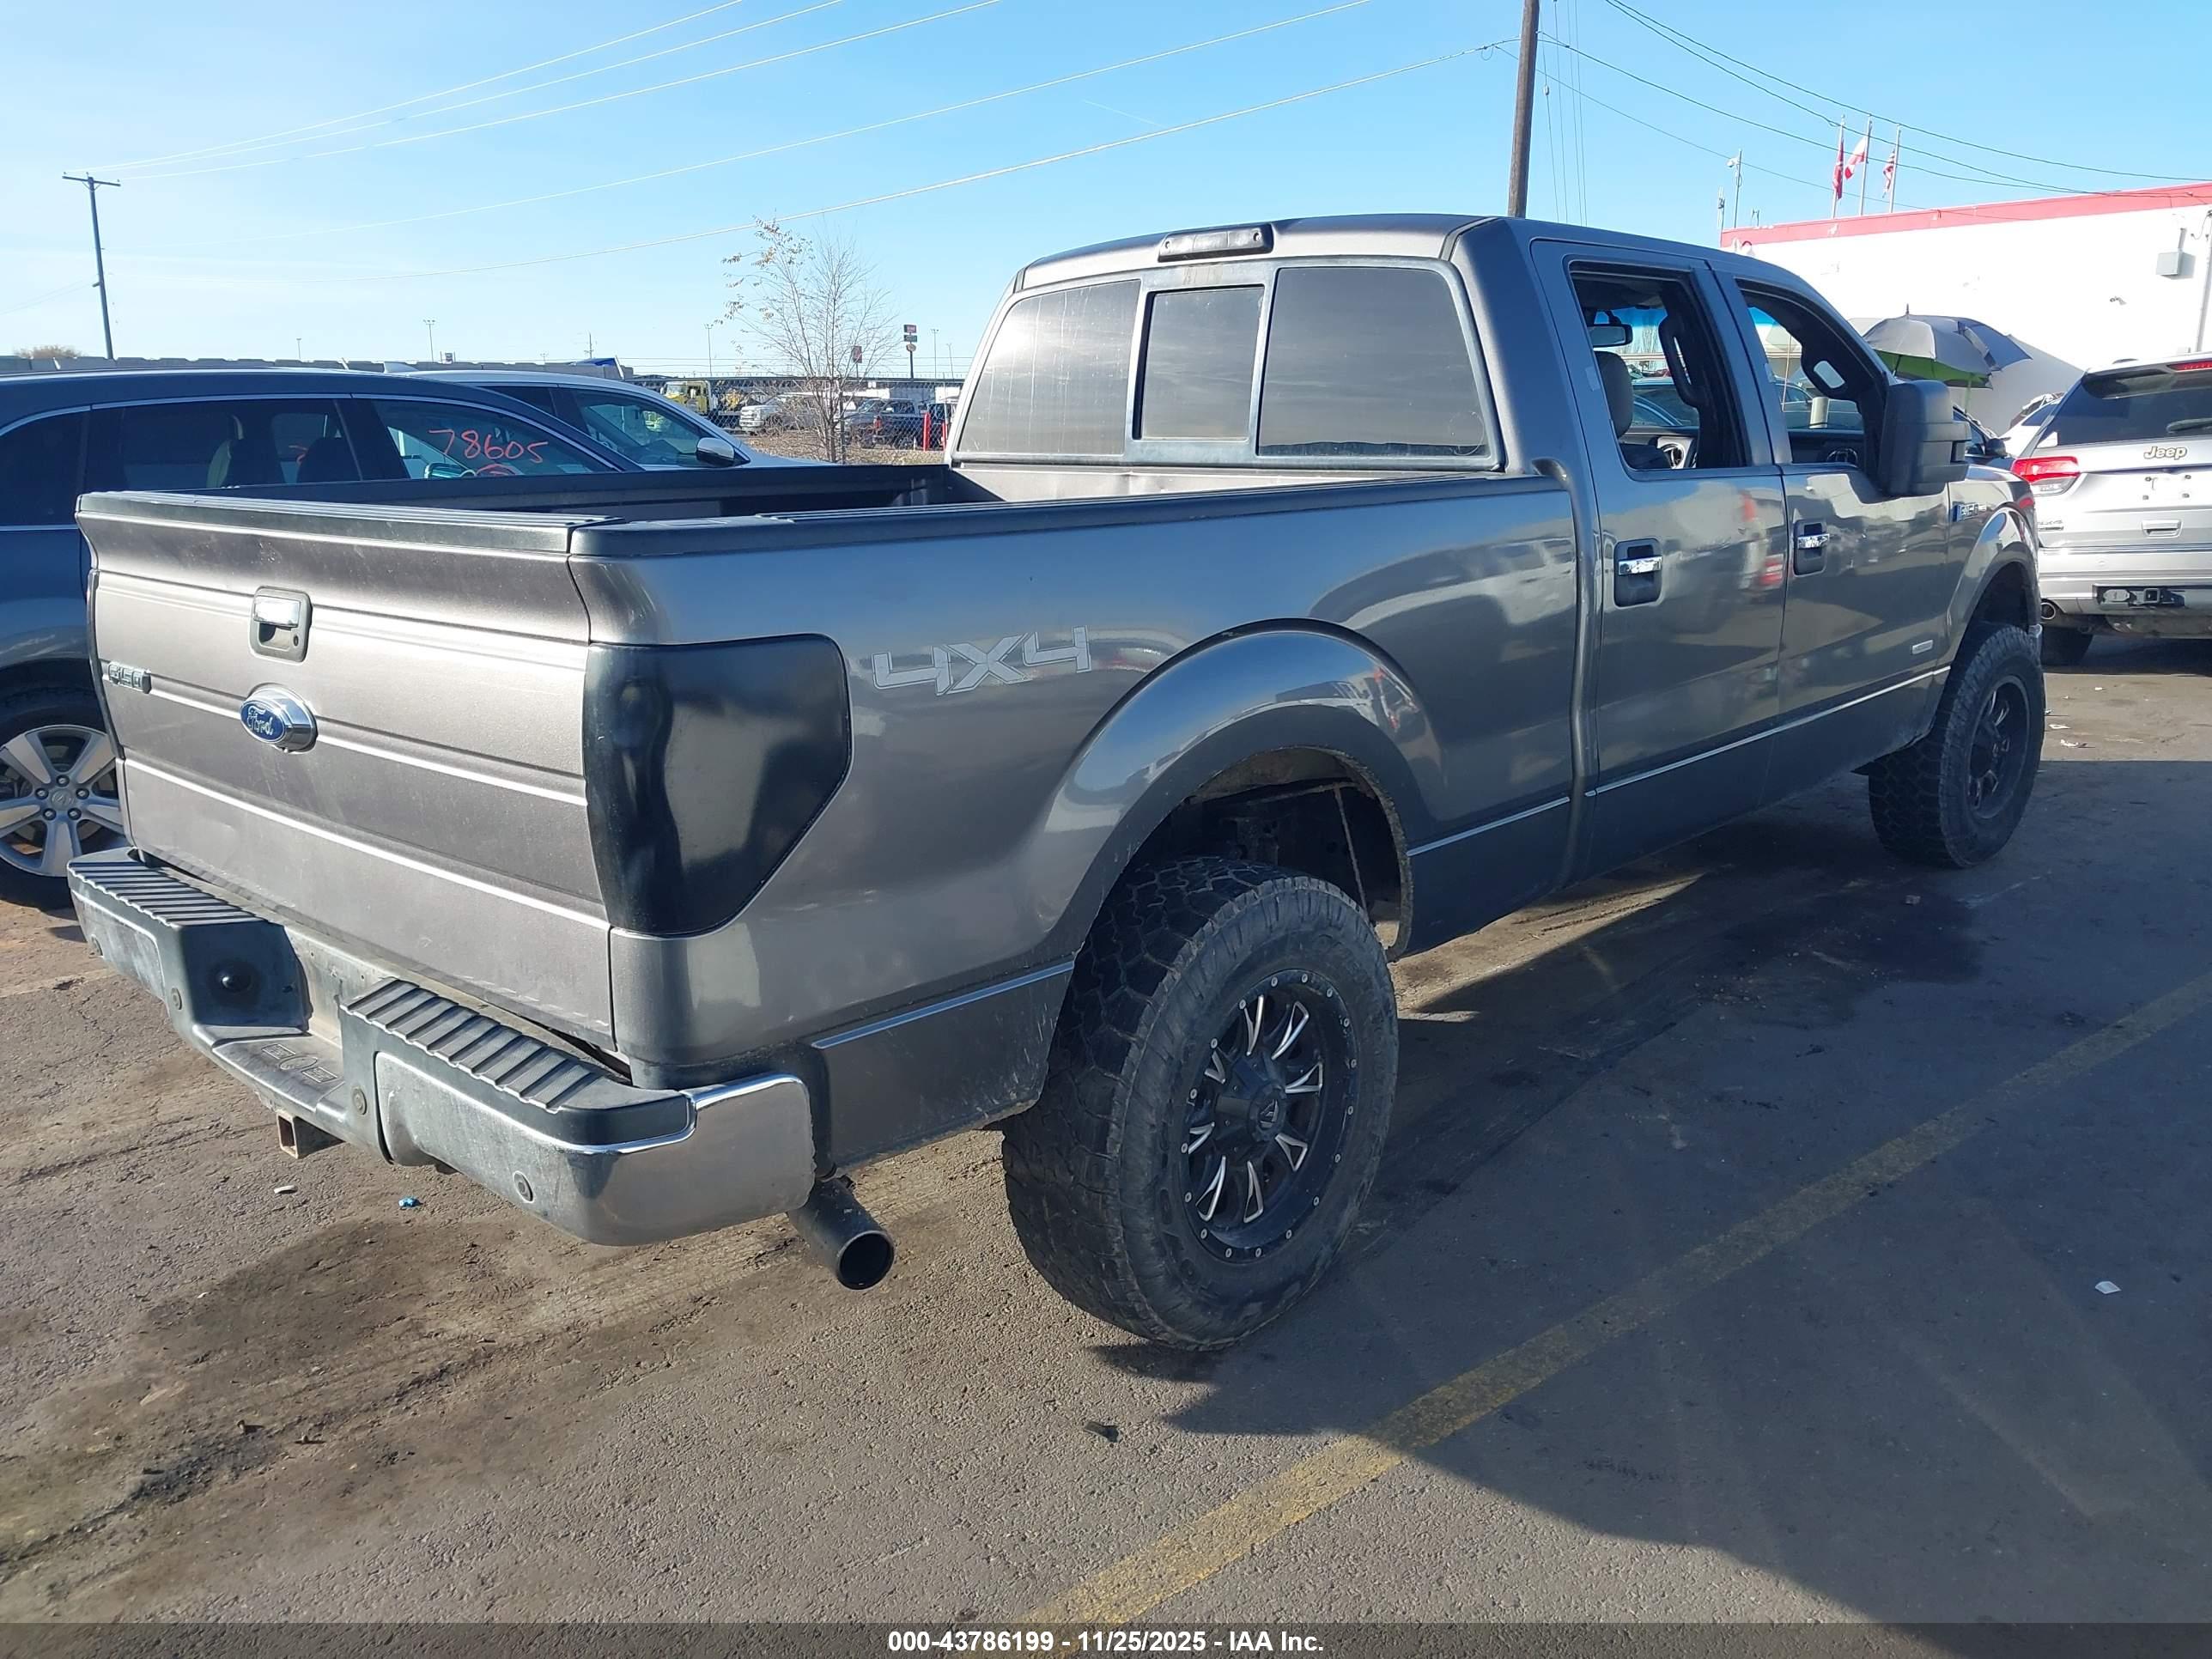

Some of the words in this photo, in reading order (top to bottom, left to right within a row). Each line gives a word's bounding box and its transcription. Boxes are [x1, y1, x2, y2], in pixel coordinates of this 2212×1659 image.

[428, 429, 549, 464] 78605
[2143, 446, 2188, 460] Jeep
[246, 705, 275, 736] Ford
